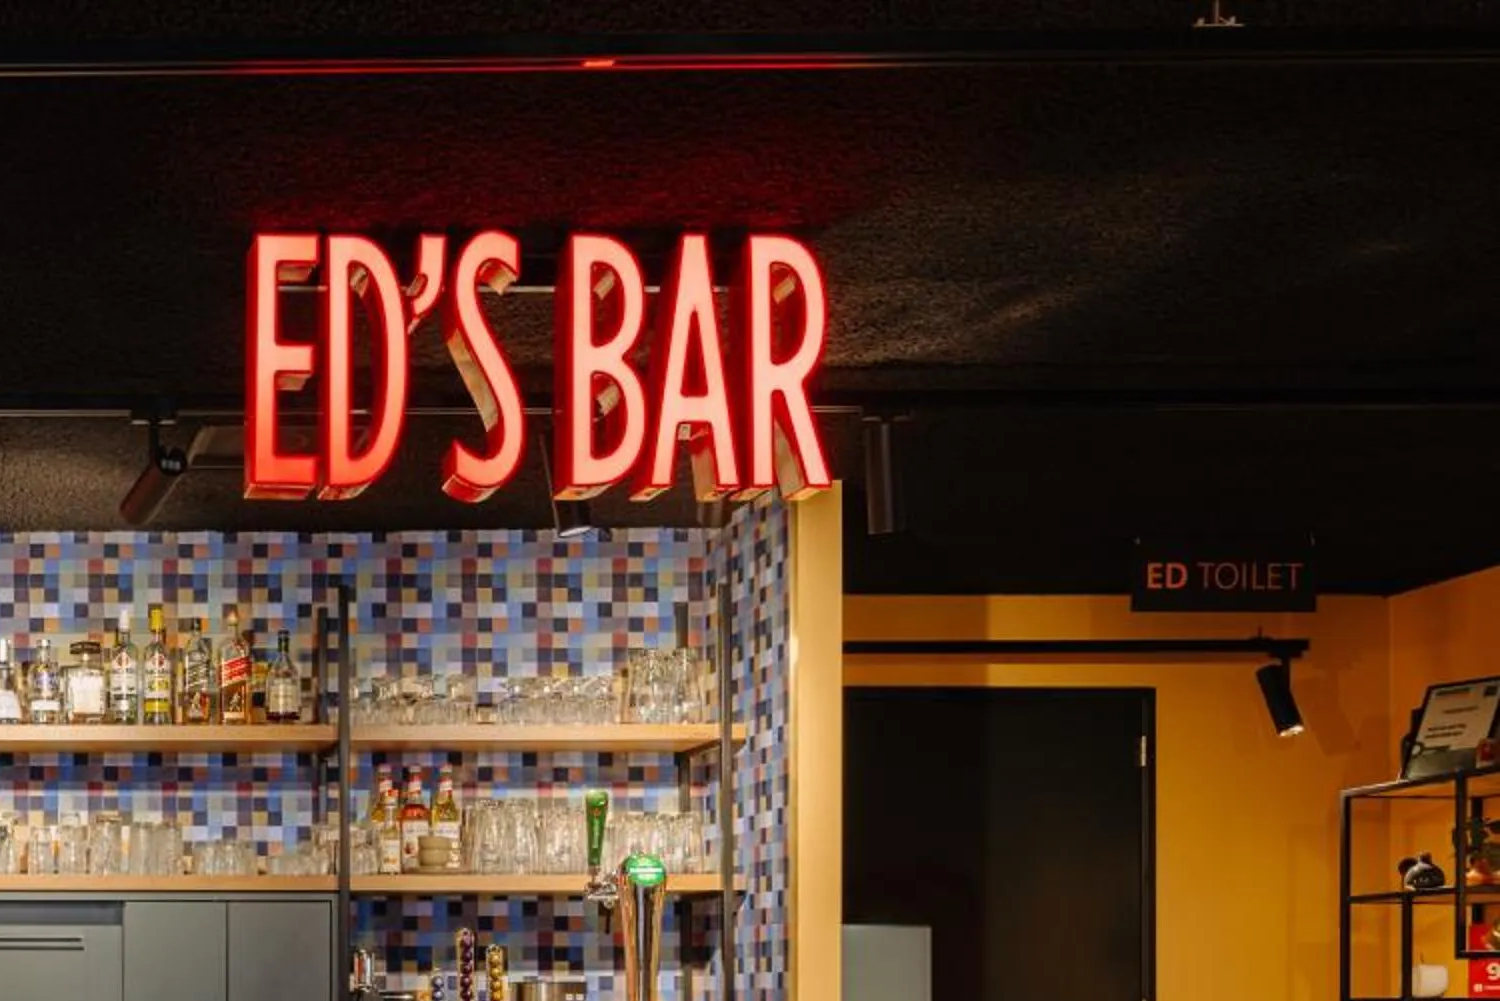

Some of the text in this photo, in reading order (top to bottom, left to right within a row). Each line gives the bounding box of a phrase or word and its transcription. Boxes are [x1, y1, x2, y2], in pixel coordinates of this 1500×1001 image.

[250, 229, 833, 490] ED'S BAR
[1146, 561, 1304, 590] ED TOILET
